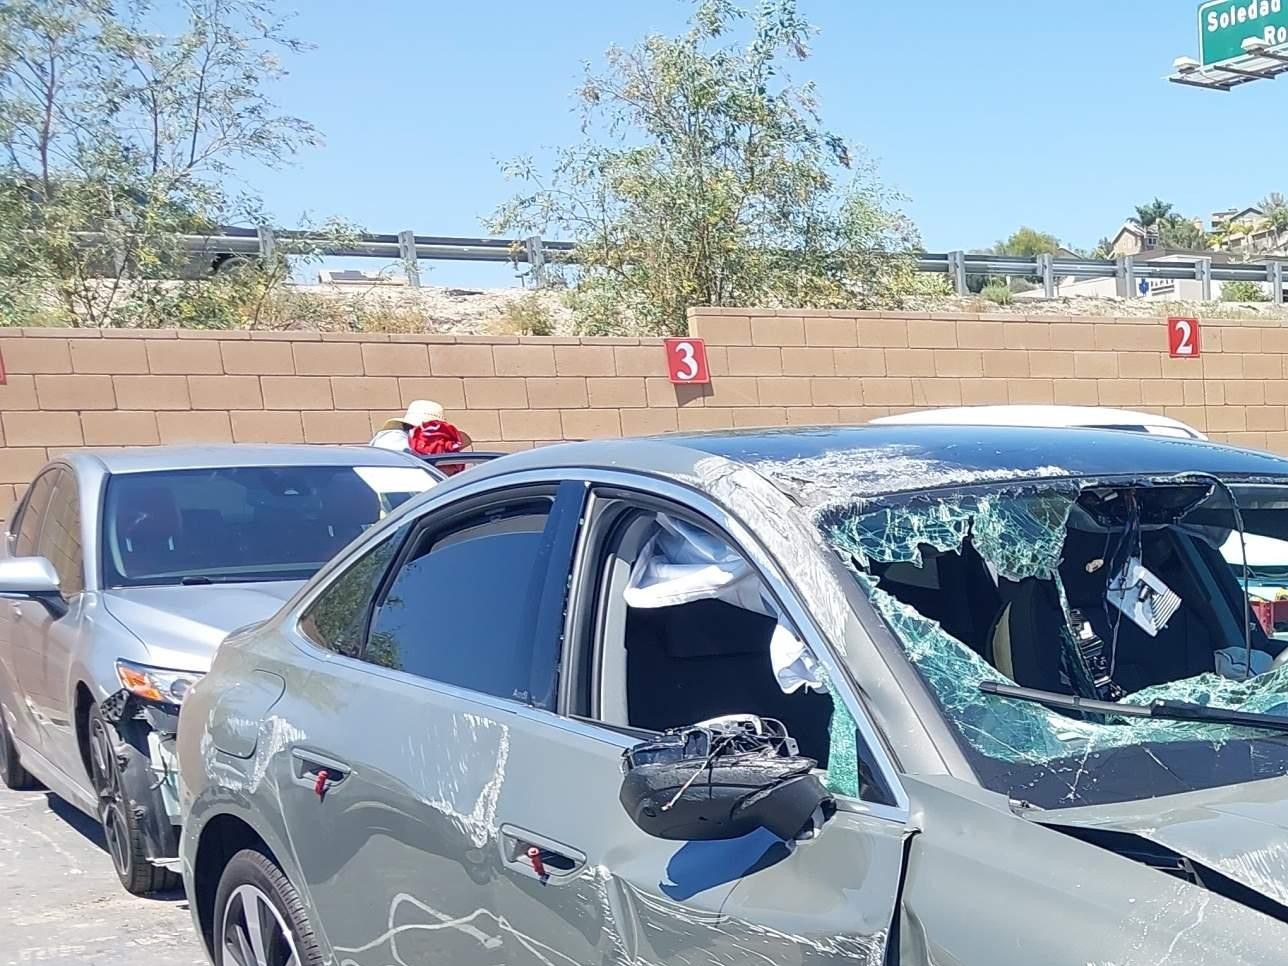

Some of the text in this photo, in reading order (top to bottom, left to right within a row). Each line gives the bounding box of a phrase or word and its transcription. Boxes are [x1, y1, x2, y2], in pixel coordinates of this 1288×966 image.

[1207, 0, 1281, 32] Soledad
[1175, 320, 1193, 354] 2
[675, 342, 698, 380] 3
